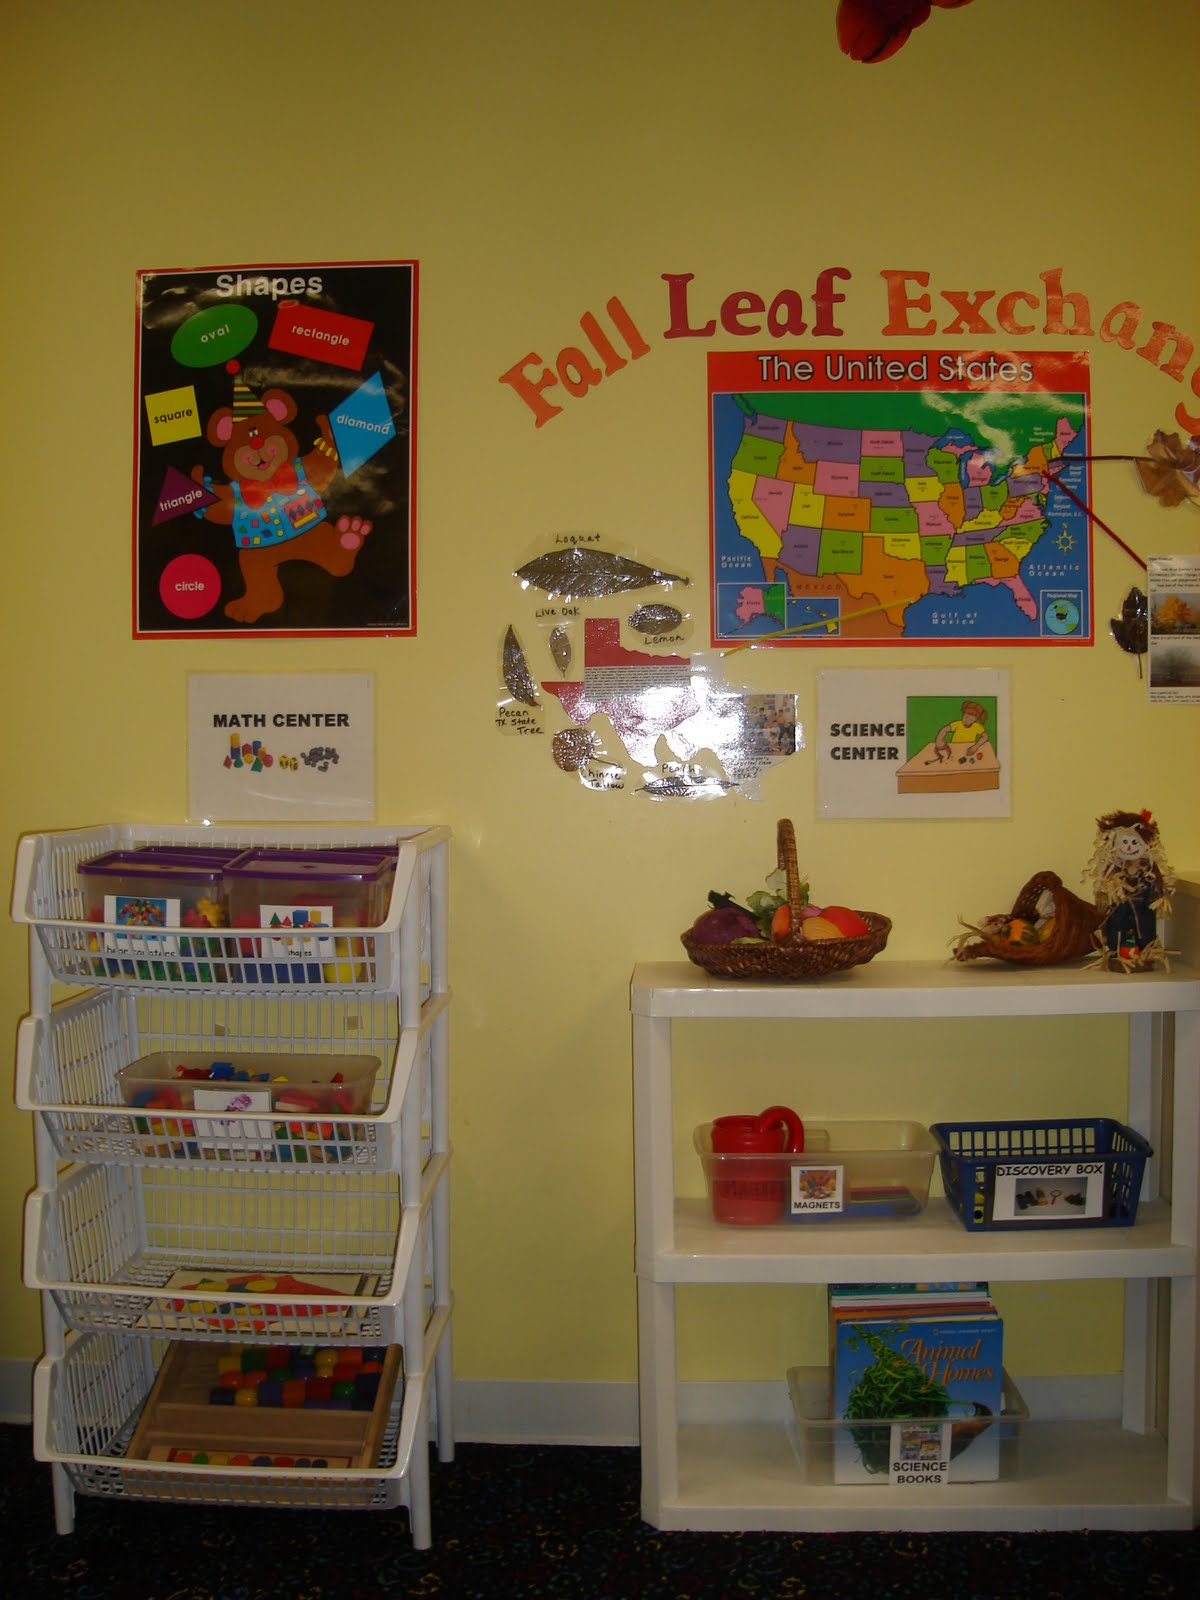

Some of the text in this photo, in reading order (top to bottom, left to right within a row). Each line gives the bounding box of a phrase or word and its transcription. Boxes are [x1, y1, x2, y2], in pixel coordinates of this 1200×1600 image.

[216, 274, 323, 300] Shapes
[200, 324, 230, 343] oval
[292, 325, 350, 347] rectangle
[498, 295, 651, 429] Fall
[661, 267, 851, 339] Leaf
[757, 354, 1034, 382] The United States
[154, 406, 193, 425] square
[336, 414, 390, 435] diamond
[159, 488, 203, 513] triangle
[556, 533, 600, 545] Loquat
[175, 580, 205, 592] circle
[536, 607, 580, 618] Live Oak
[645, 635, 685, 645] Lemon
[499, 707, 529, 717] Pecan
[213, 713, 350, 727] MATH CENTER
[517, 726, 544, 735] Tree
[830, 723, 905, 737] SCIENCE
[830, 747, 899, 760] CENTER
[997, 1164, 1103, 1176] DISCOVERY BOX
[793, 1201, 841, 1210] MAGNETS
[901, 1337, 983, 1366] Animal
[920, 1360, 993, 1391] Homes
[893, 1462, 947, 1472] SCIENCE
[897, 1475, 942, 1484] BOOKS
